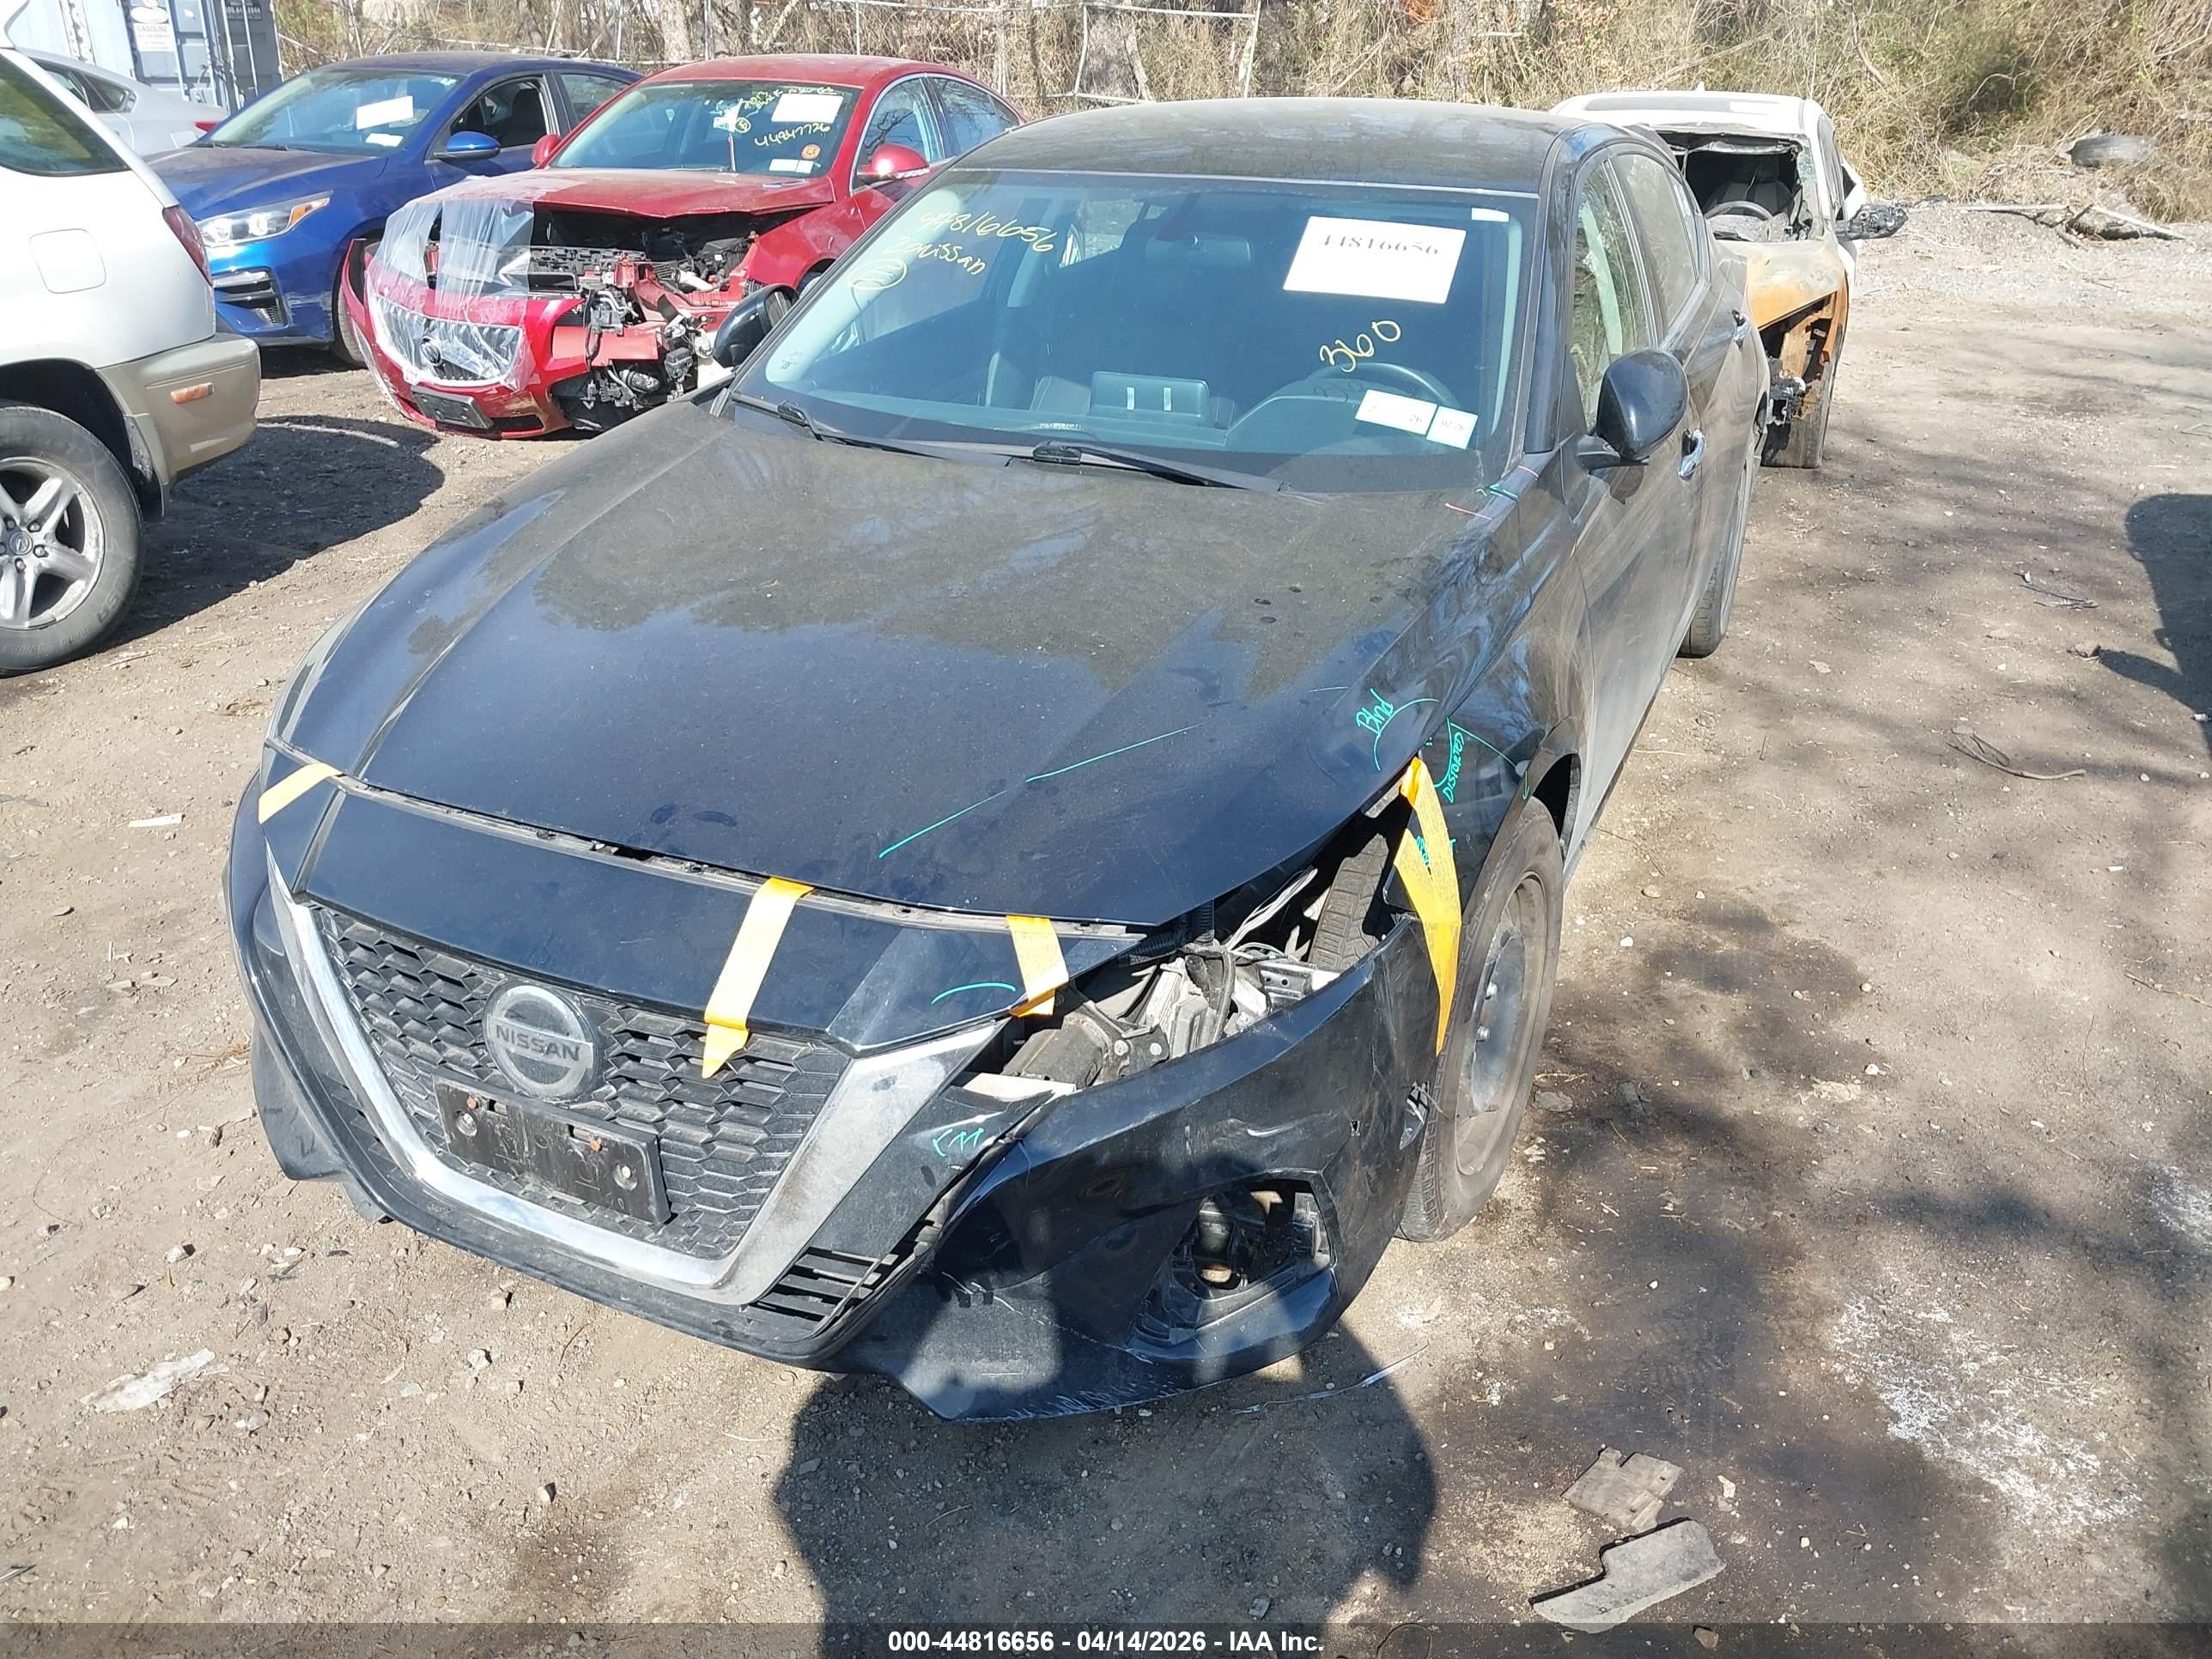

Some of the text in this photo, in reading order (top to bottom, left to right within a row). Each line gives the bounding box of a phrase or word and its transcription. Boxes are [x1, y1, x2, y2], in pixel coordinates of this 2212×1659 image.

[919, 211, 1057, 252] 44816656
[1319, 320, 1401, 373] 360
[1443, 732, 1465, 804] DISTORTED
[495, 1024, 580, 1061] NISSAN
